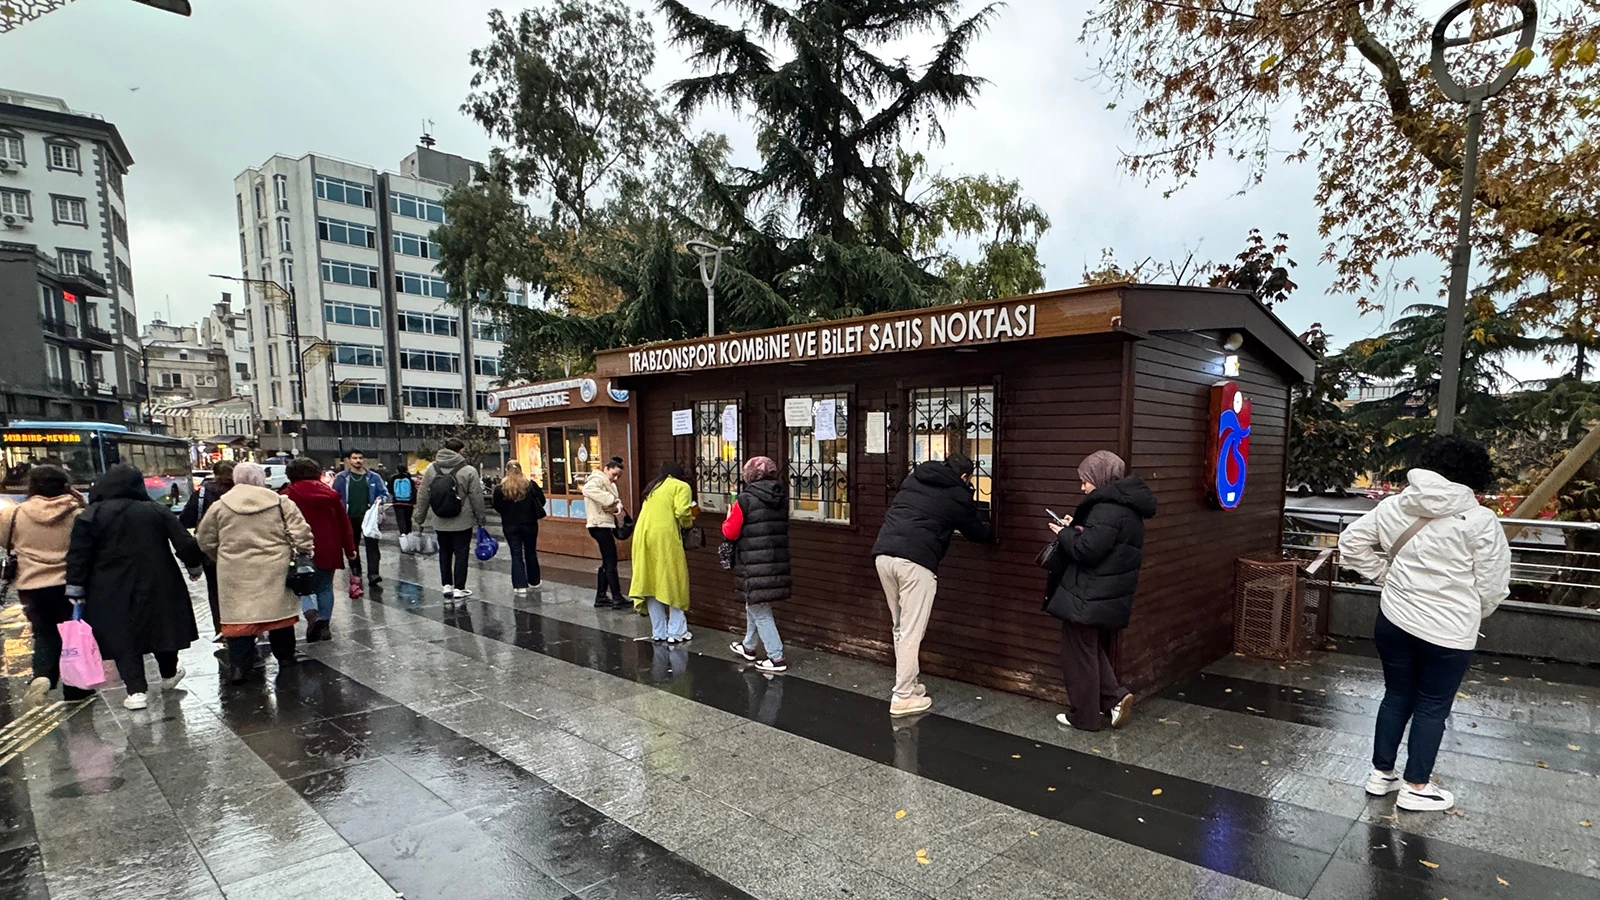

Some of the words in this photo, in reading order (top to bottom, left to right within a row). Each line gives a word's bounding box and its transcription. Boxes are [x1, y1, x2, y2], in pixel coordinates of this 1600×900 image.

[629, 343, 716, 373] TRABZONSPOR
[794, 330, 817, 357] VE
[868, 317, 923, 351] SATIŞ
[931, 304, 1036, 345] NOKTASI
